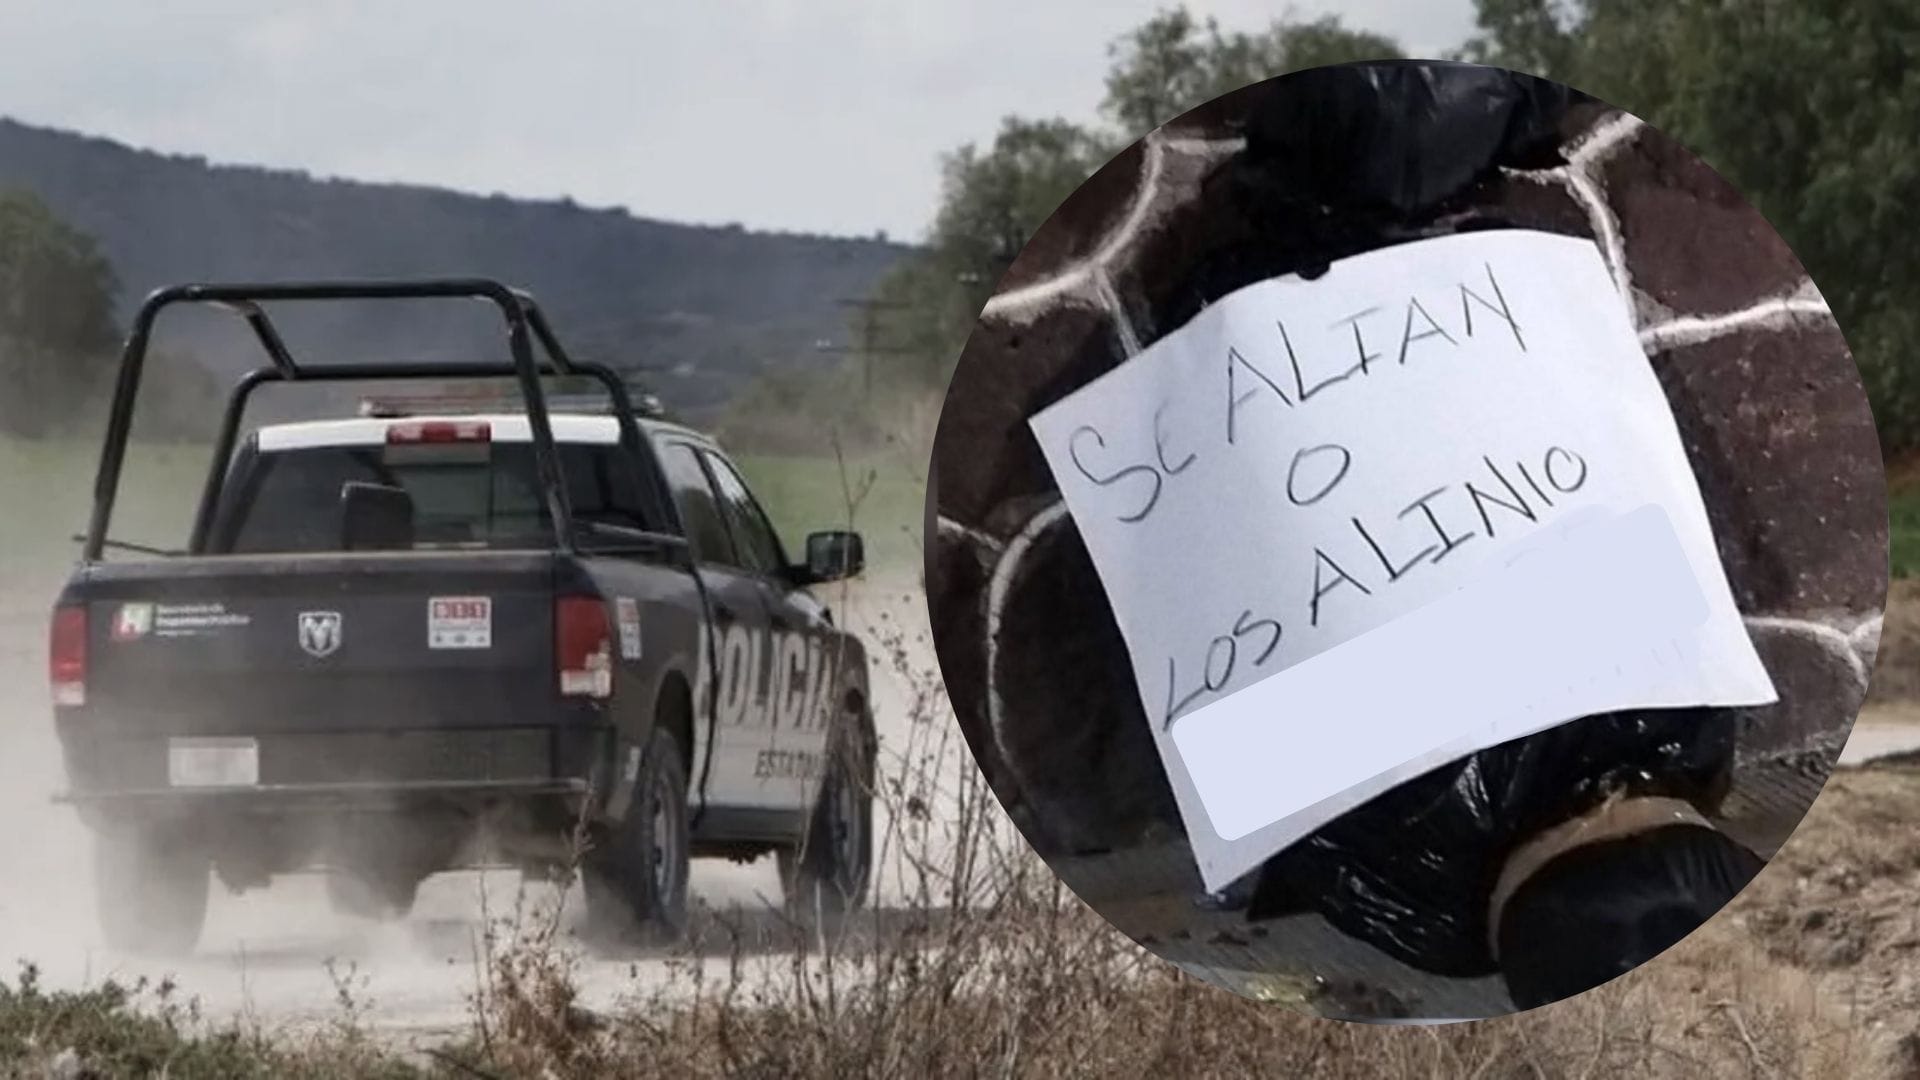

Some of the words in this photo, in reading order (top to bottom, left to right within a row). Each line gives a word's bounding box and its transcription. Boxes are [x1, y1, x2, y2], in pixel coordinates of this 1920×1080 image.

[1225, 262, 1527, 444] ALIAN
[1287, 443, 1351, 506] O
[1162, 610, 1282, 732] LOS
[1310, 446, 1588, 626] ALINIO
